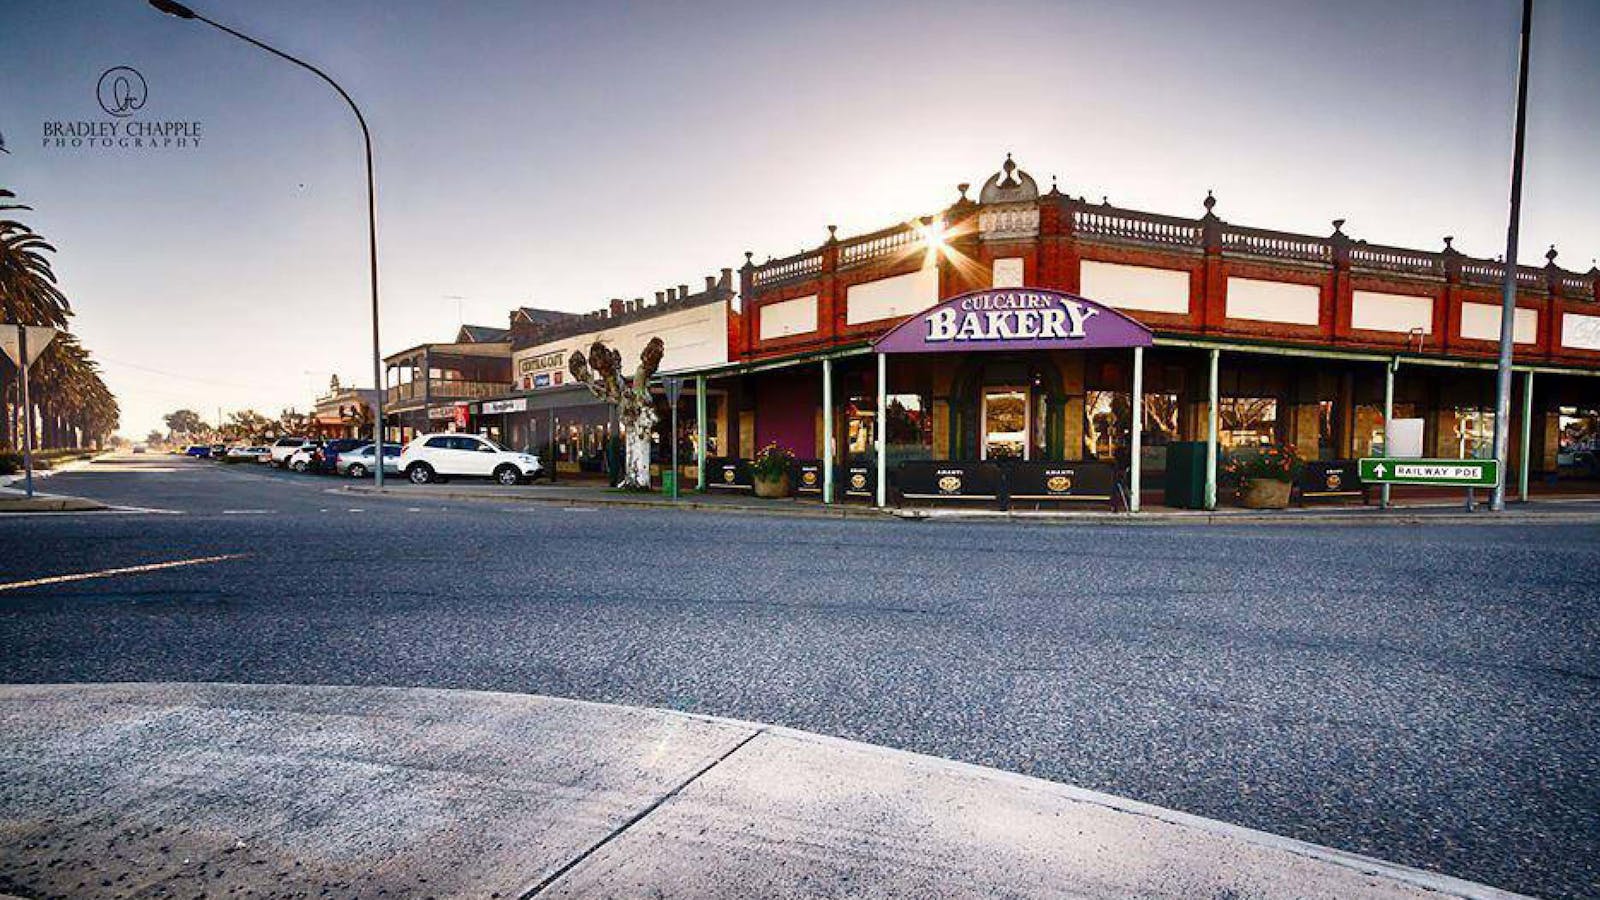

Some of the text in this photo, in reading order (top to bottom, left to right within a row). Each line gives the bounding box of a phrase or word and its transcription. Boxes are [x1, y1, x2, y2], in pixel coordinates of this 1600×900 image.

[961, 293, 1052, 310] CULCAIRN
[925, 298, 1100, 342] BAKERY
[1398, 466, 1479, 477] RAILWAY PDE
